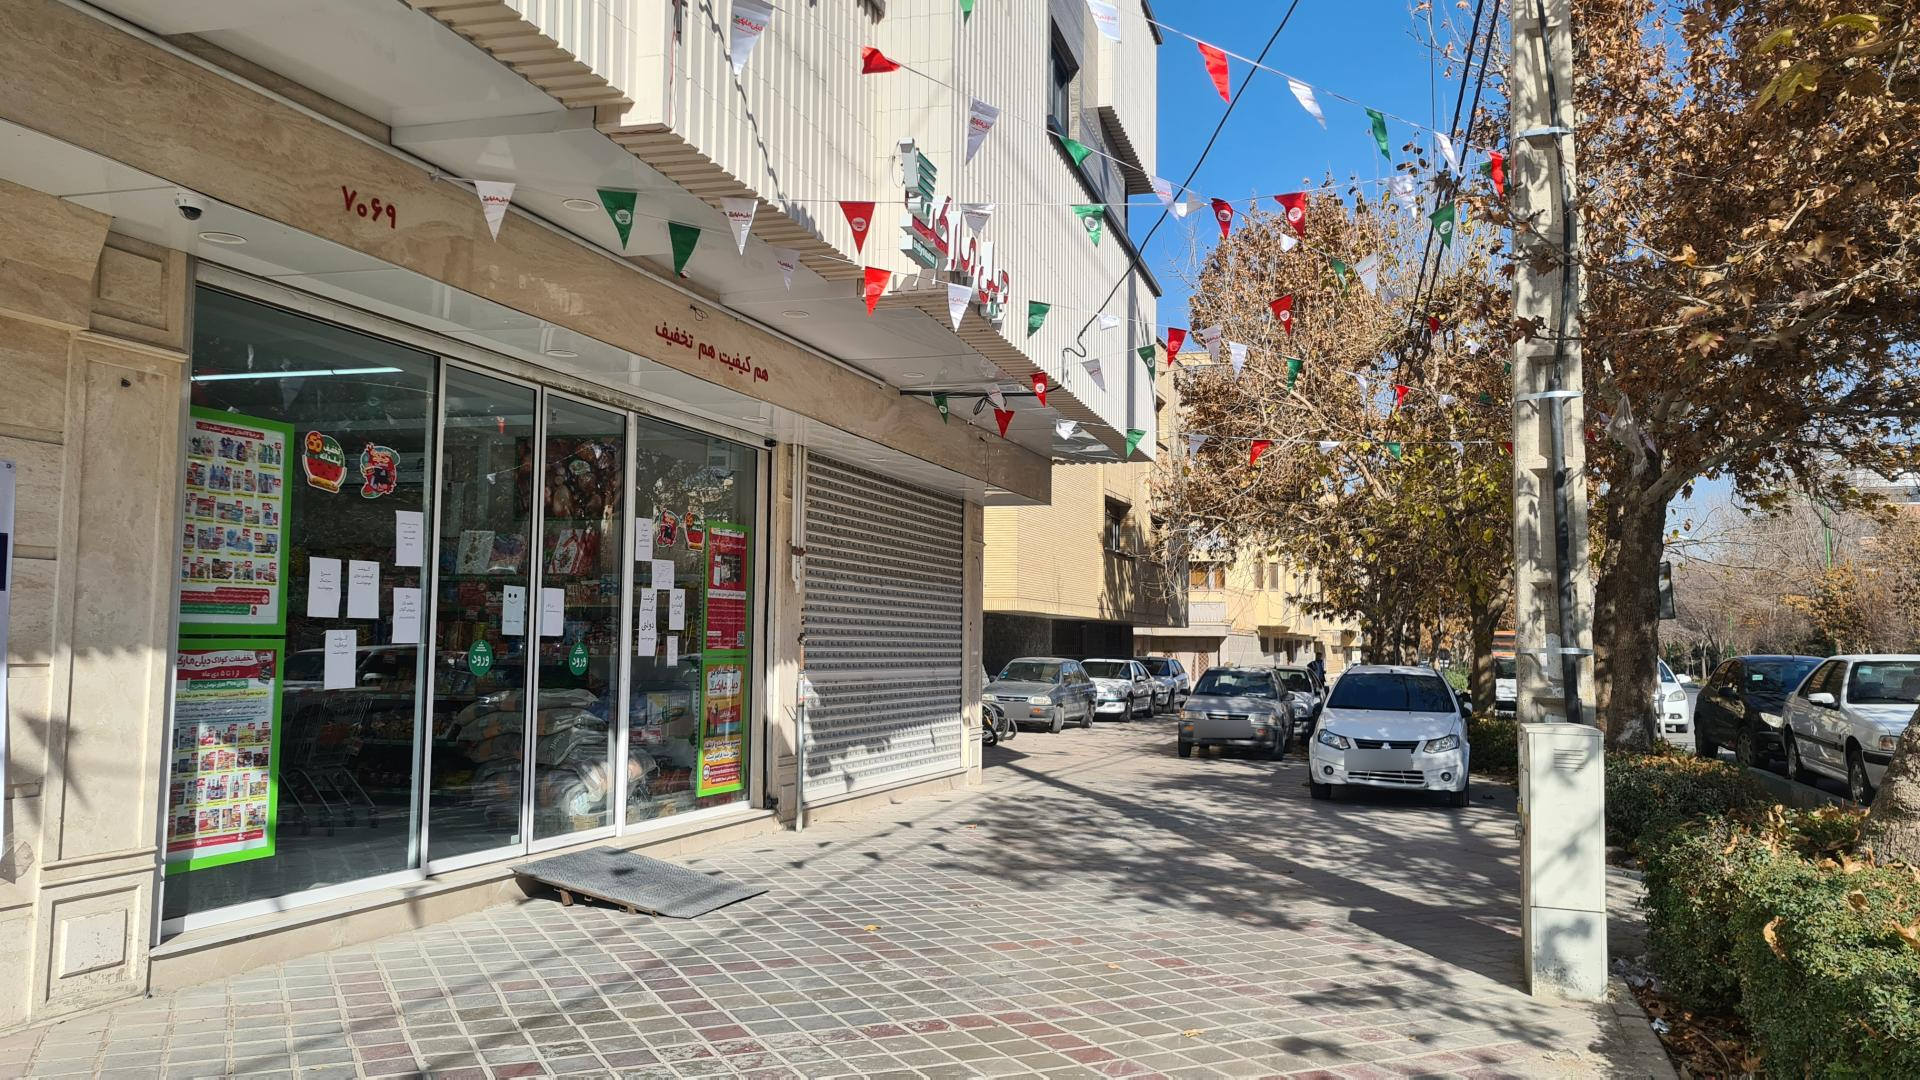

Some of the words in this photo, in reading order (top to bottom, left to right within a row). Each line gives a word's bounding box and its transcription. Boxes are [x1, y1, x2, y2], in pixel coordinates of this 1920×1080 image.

[341, 185, 396, 229] ۷۰۶۹
[655, 321, 694, 349] تخفیف
[698, 343, 715, 360] هم
[719, 352, 751, 374] کیفیت
[753, 366, 769, 383] هم
[177, 656, 195, 668] مارک
[472, 655, 490, 667] ورود
[572, 656, 587, 668] ورود
